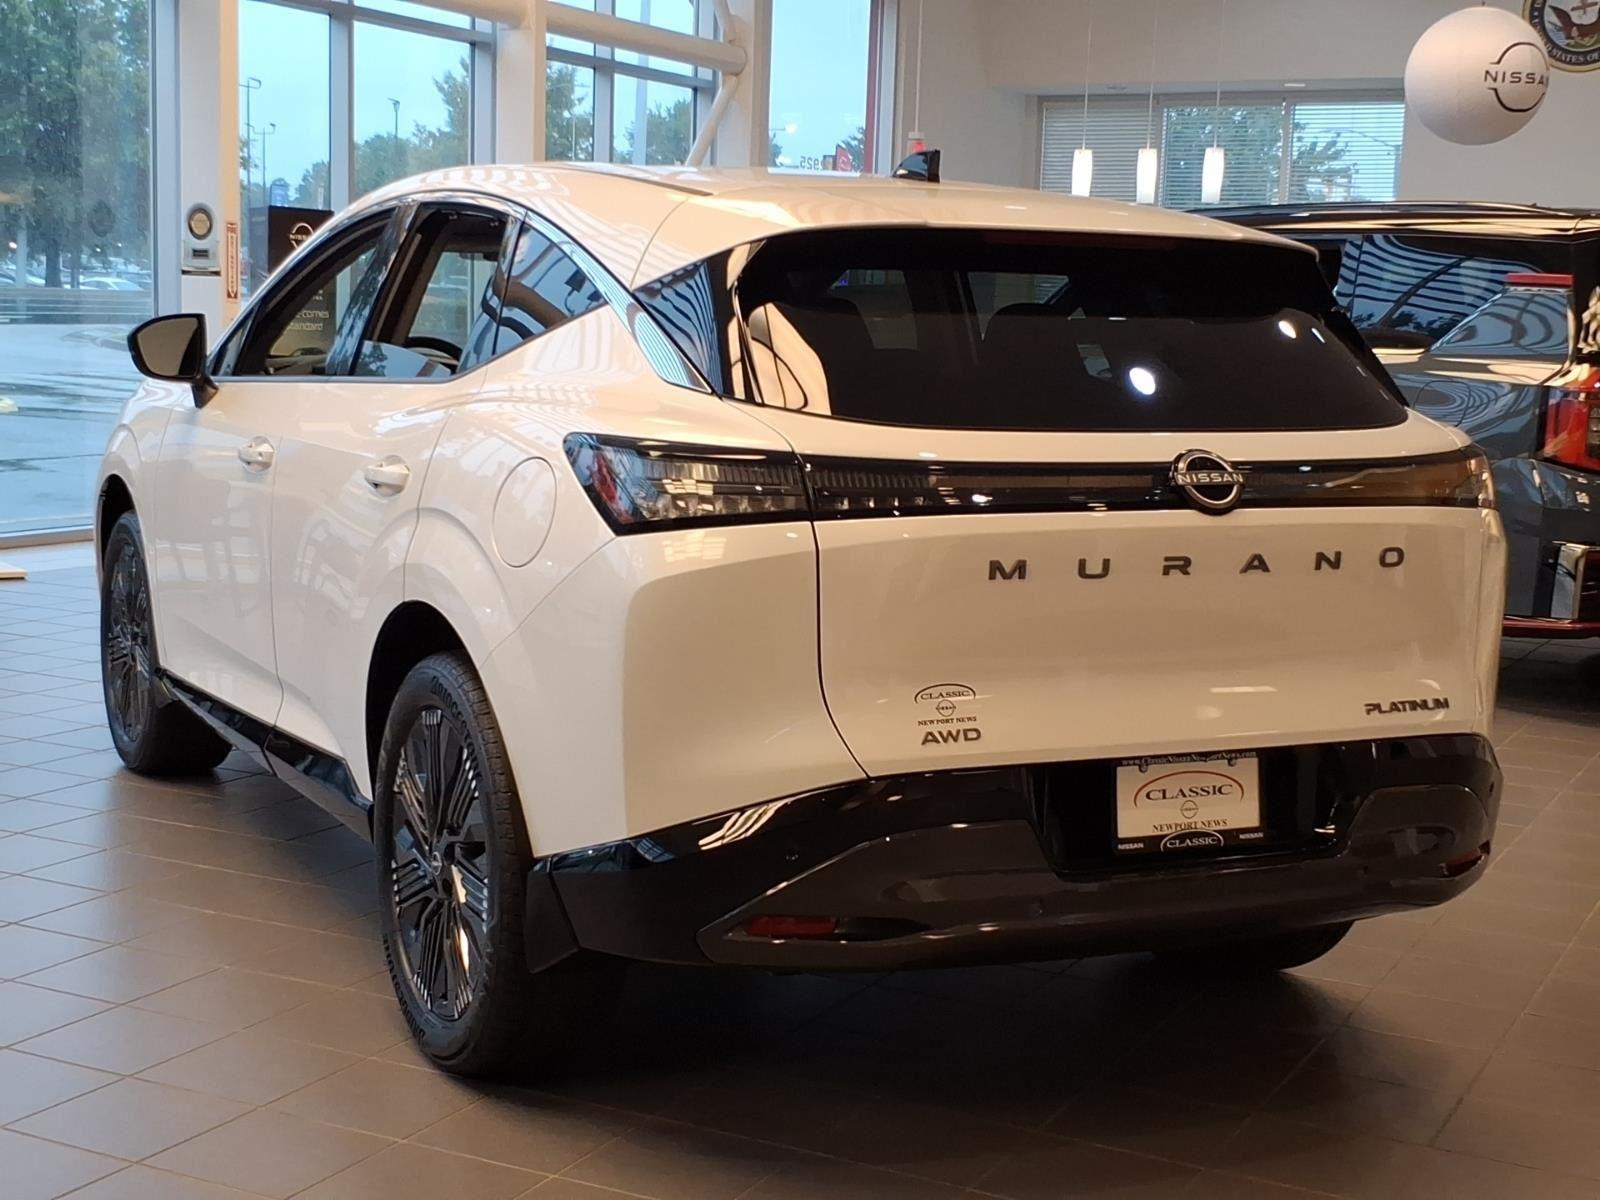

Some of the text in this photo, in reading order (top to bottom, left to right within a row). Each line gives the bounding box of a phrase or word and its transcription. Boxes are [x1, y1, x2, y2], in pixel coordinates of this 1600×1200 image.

[1177, 472, 1243, 483] NISSAN
[988, 546, 1405, 580] MURANO
[920, 690, 970, 700] CLASSIC
[1364, 697, 1449, 715] PLATINUM
[921, 728, 982, 746] AWD
[1145, 784, 1233, 801] CLASSIC
[1152, 819, 1228, 833] NEWPORT NEWS
[1118, 842, 1144, 850] NISSAN
[1166, 836, 1218, 848] CLASSIC
